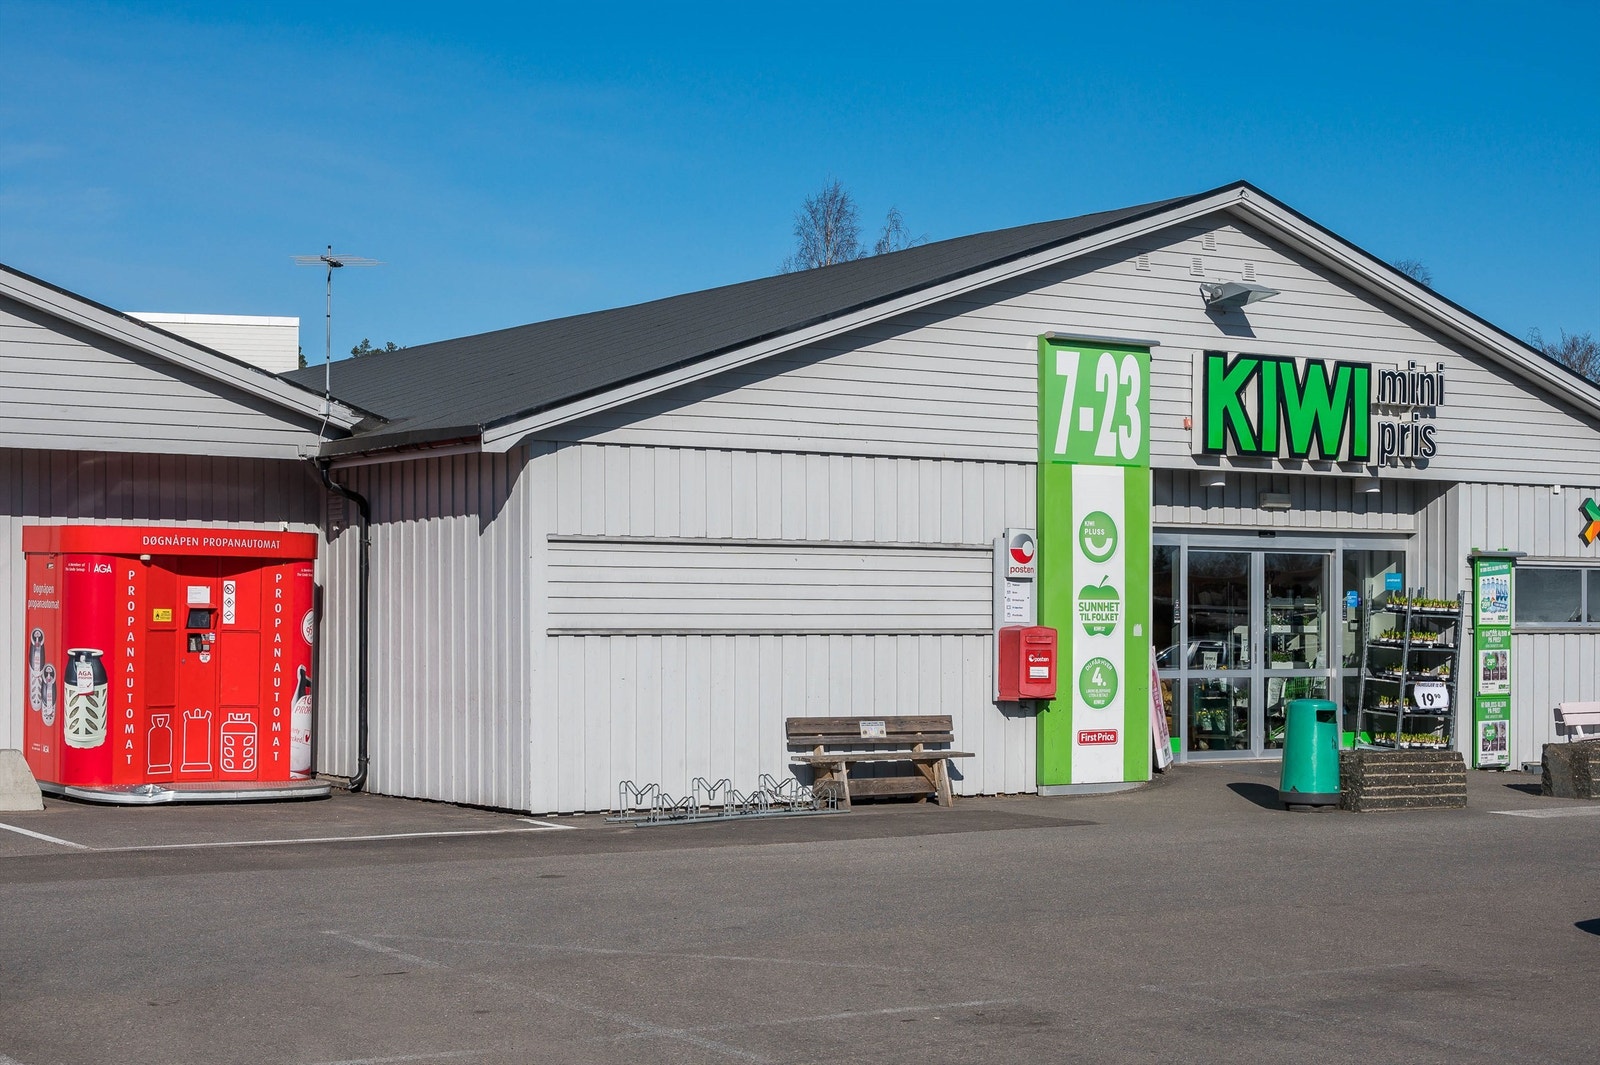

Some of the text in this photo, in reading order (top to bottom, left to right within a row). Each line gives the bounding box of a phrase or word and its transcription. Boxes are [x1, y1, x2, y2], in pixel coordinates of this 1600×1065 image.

[1378, 360, 1445, 407] mini
[1054, 350, 1142, 460] 7-23
[1203, 350, 1372, 462] KIWI
[1378, 412, 1437, 467] pris
[142, 534, 281, 549] DØGNÅPEN PROPANAUTOMAT
[93, 563, 112, 573] AGA
[1010, 566, 1034, 574] posten
[1078, 602, 1120, 612] SUNNHET
[1080, 613, 1119, 621] TIL FOLKET
[124, 570, 135, 765] PROPANAUTOMAT
[272, 573, 282, 761] PROPANAUTOMAT
[1101, 660, 1113, 671] HVER
[1091, 667, 1107, 687] 4.
[1081, 732, 1115, 742] First Price
